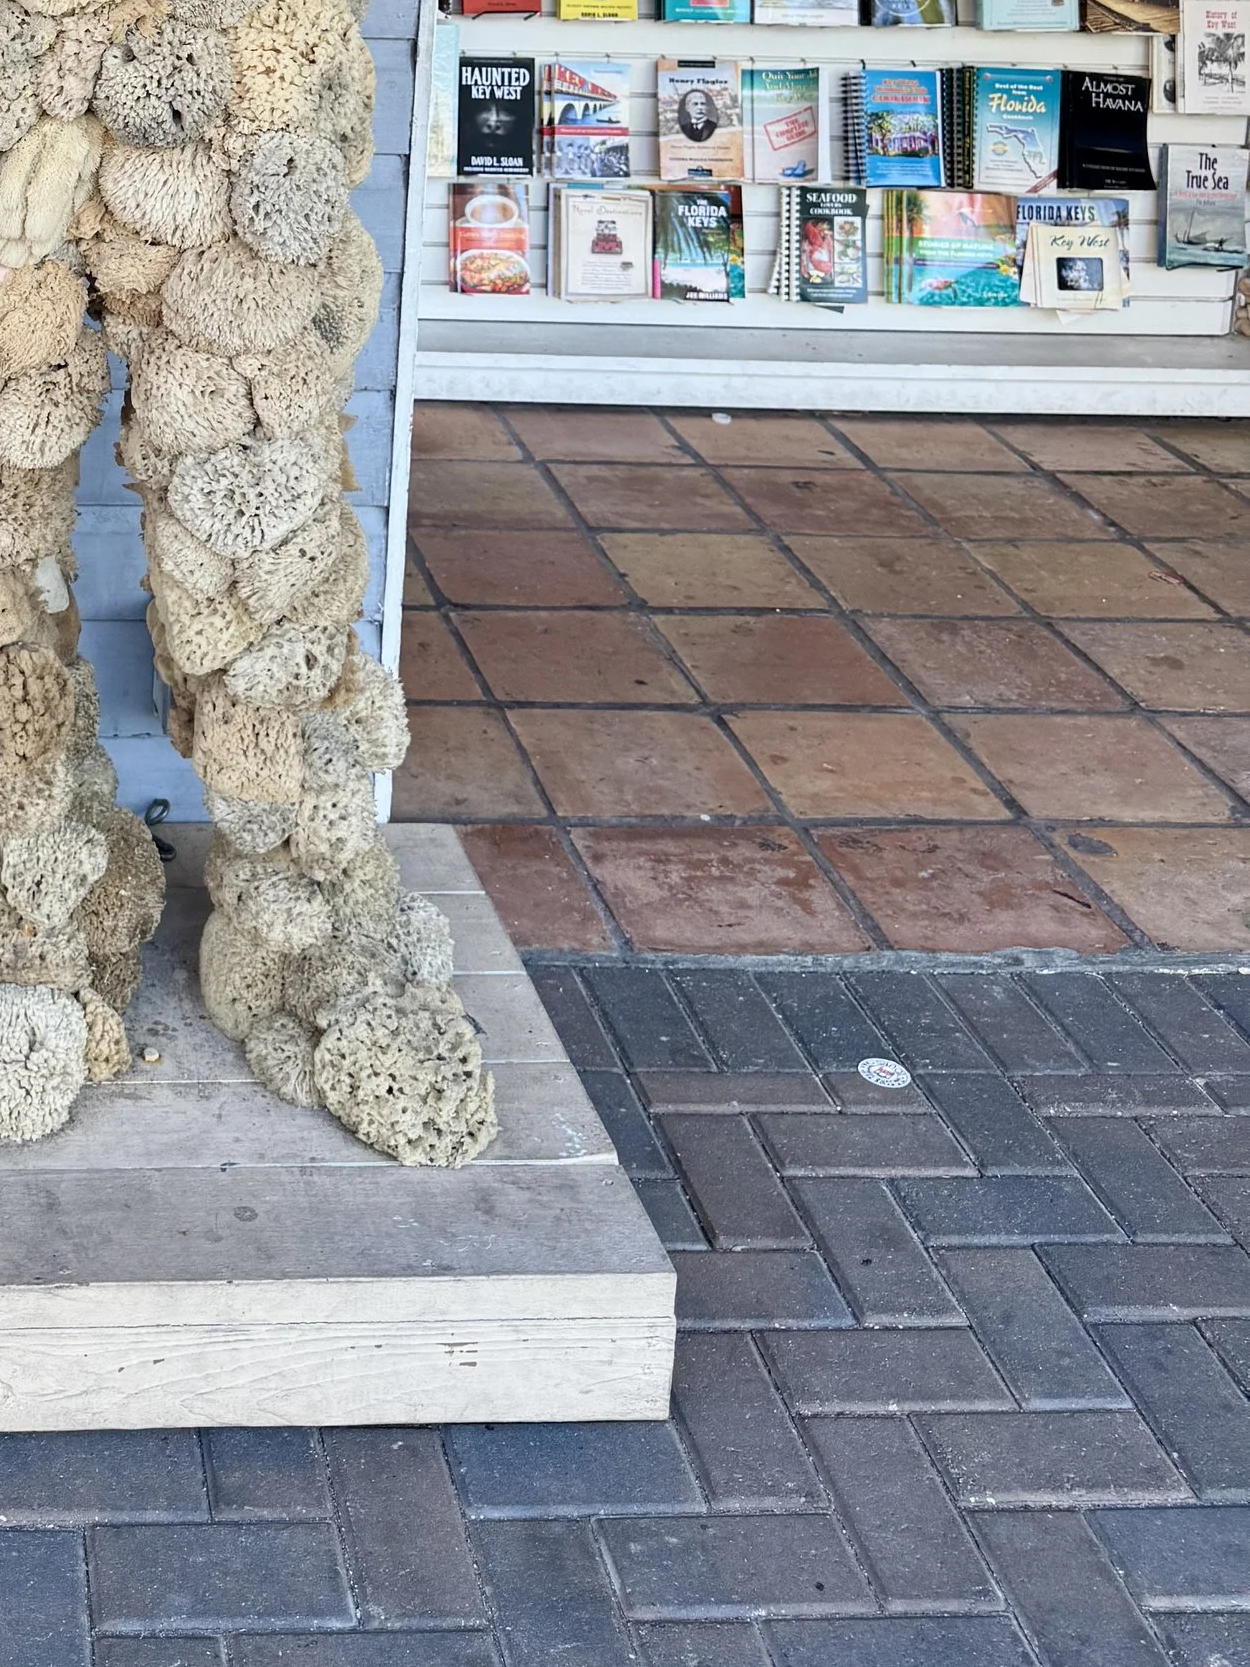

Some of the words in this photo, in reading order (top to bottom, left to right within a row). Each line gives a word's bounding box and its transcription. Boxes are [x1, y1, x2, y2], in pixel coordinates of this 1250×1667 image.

[1206, 10, 1227, 20] History
[1230, 10, 1238, 20] of
[1206, 20, 1219, 30] Key
[1221, 21, 1237, 30] West
[461, 67, 530, 86] HAUNTED
[668, 77, 695, 86] Henry
[696, 77, 728, 86] Flagler
[762, 70, 783, 81] Quit
[786, 71, 806, 80] Your
[1081, 76, 1135, 96] ALMOST
[471, 86, 492, 99] KEY
[494, 86, 522, 100] WEST
[988, 92, 1047, 114] Florida
[1091, 93, 1145, 113] HAVANA
[471, 156, 492, 167] DAVID
[501, 157, 523, 167] SLOAN
[1198, 152, 1218, 171] The
[1185, 169, 1209, 190] True
[1211, 172, 1230, 190] Sea
[696, 198, 708, 206] THE
[806, 192, 857, 203] SEAFOOD
[572, 204, 594, 215] Novel
[596, 203, 643, 216] Destinations
[677, 205, 727, 218] FLORIDA
[809, 207, 853, 216] COOKBOOK
[1016, 204, 1063, 221] FLORIDA
[1066, 205, 1095, 222] KEYS
[687, 216, 717, 229] KEYS
[918, 239, 950, 249] STORIES
[951, 241, 962, 249] OF
[1050, 234, 1074, 251] Key
[1078, 234, 1111, 248] West
[685, 291, 698, 300] JOE
[698, 291, 728, 301] WILLIAMS
